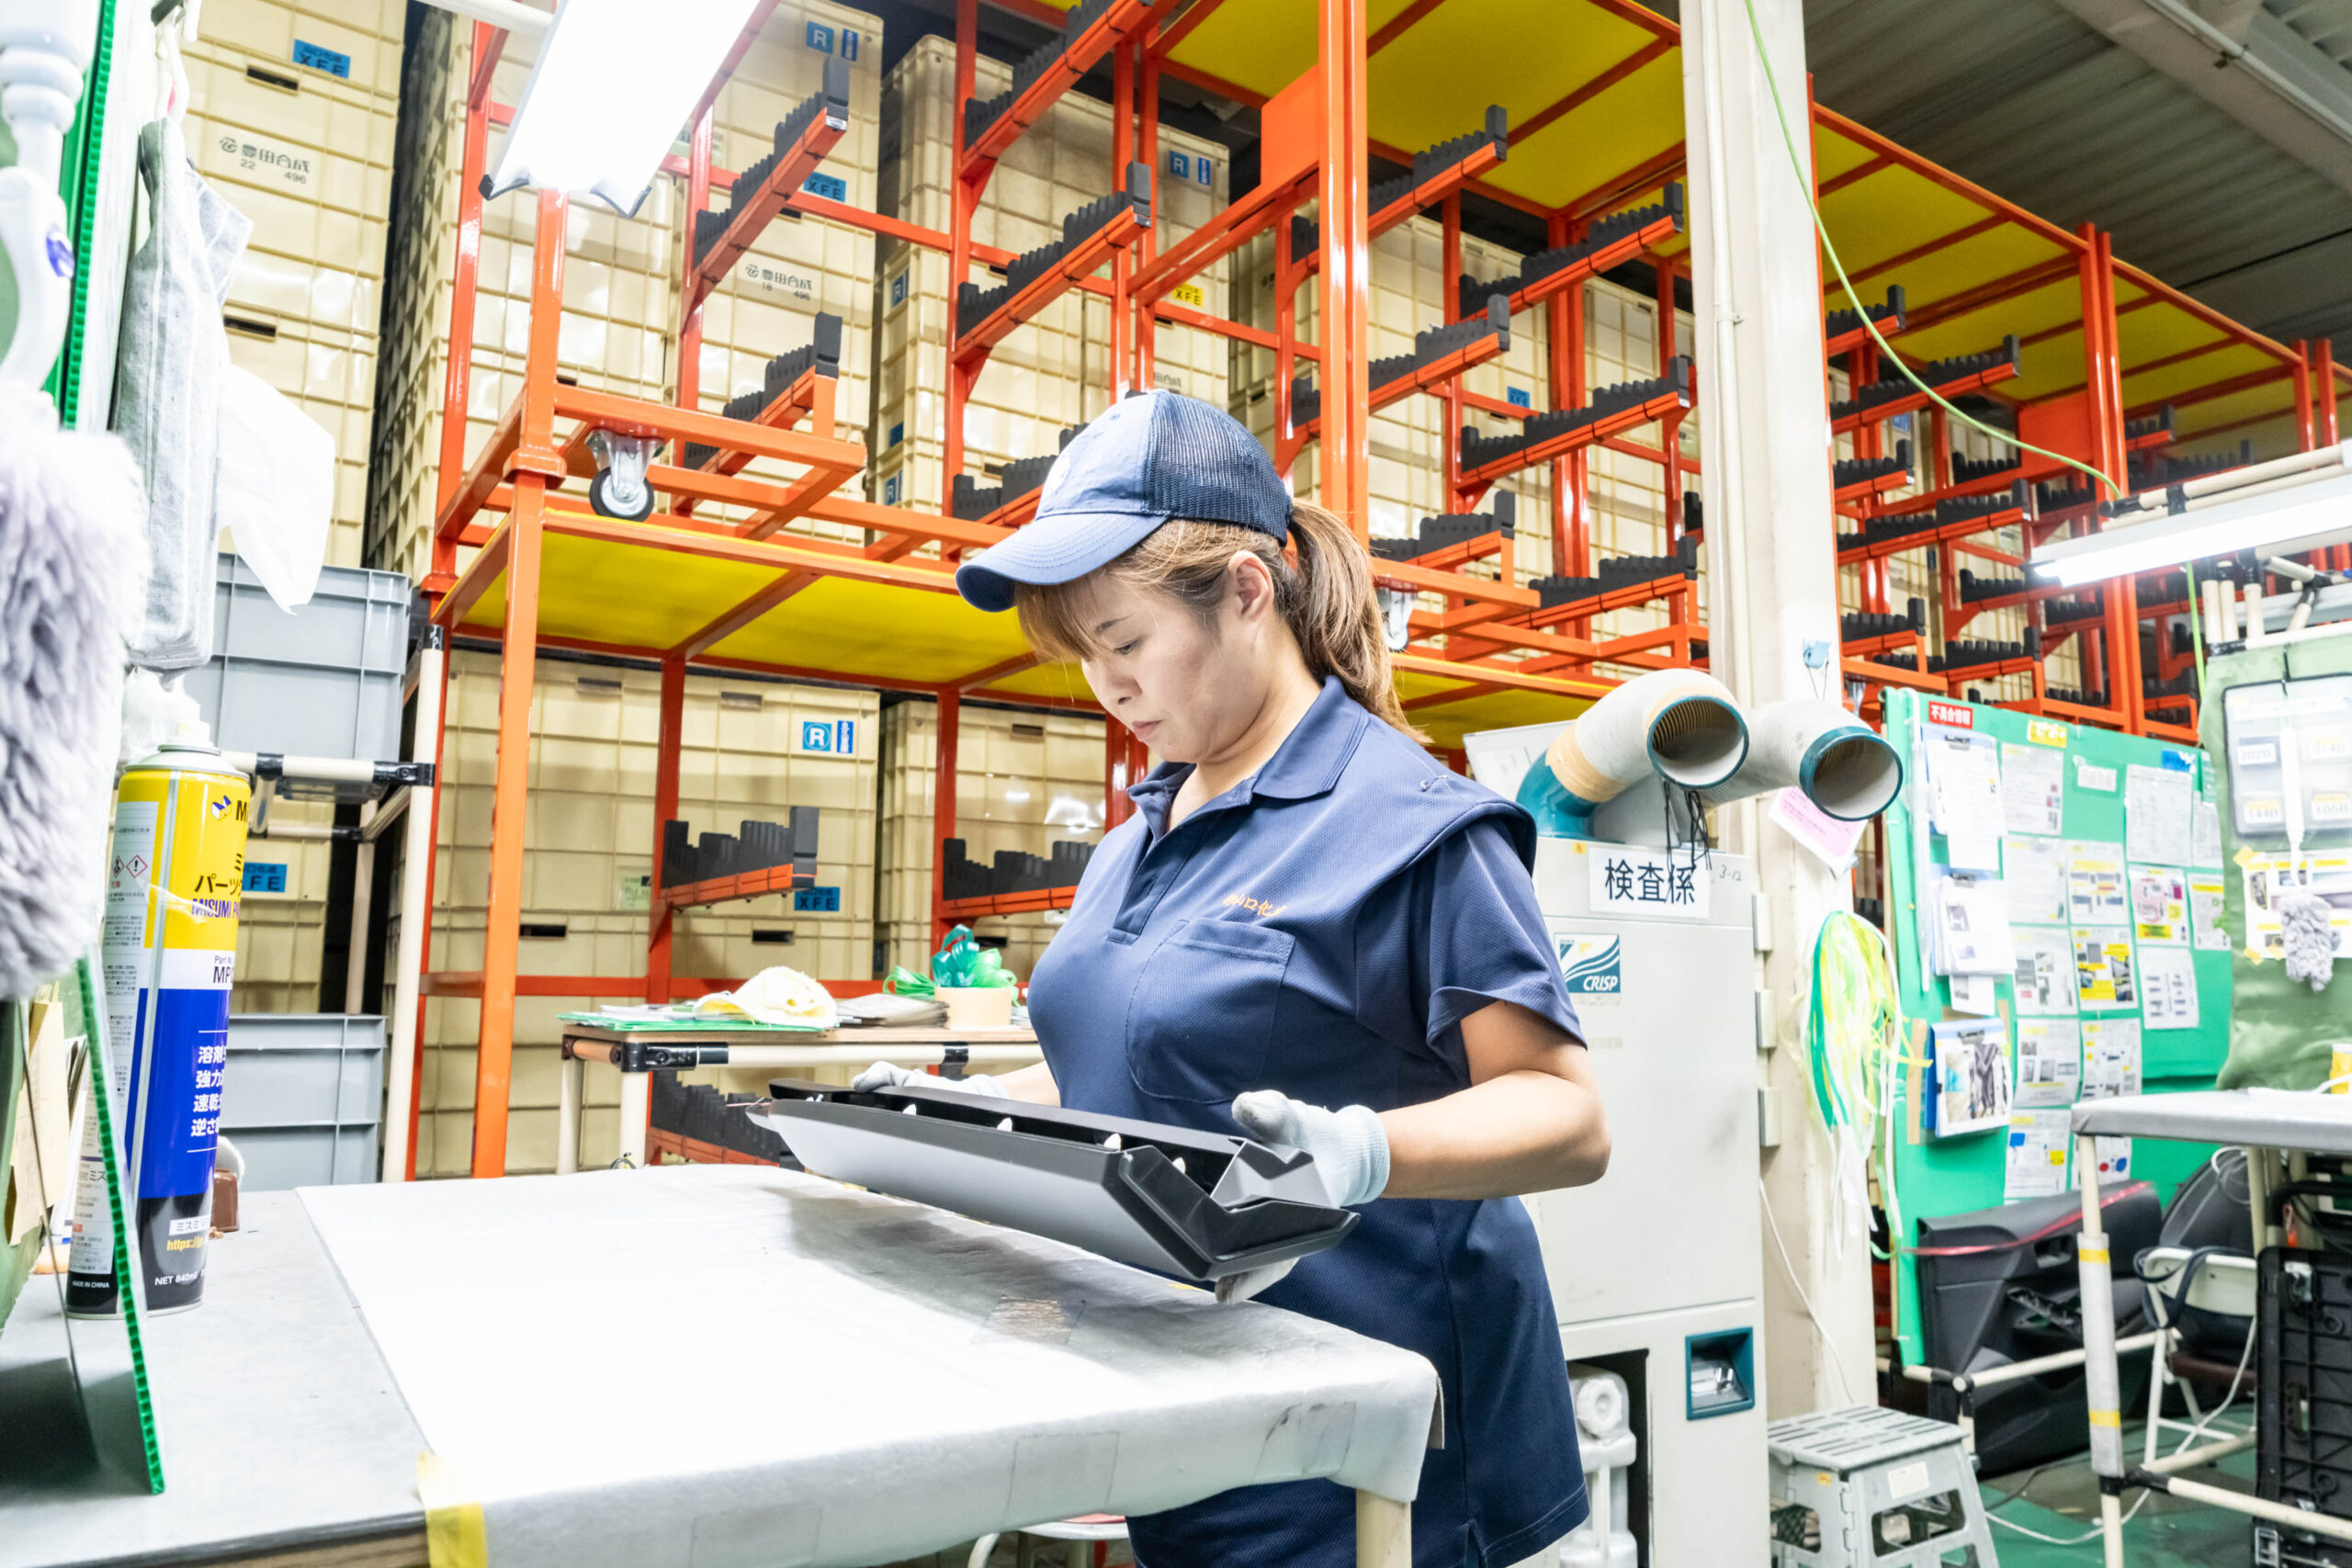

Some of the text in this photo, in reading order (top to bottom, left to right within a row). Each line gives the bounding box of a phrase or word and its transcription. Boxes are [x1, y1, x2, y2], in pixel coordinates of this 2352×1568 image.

[809, 728, 825, 746] R
[235, 800, 248, 823] M
[194, 874, 242, 897] パーツ
[1605, 858, 1697, 905] 検査係
[799, 897, 835, 910] XFE
[213, 966, 234, 984] MP
[1583, 976, 1618, 991] CRISP
[198, 1045, 227, 1065] 溶剤
[196, 1069, 224, 1089] 強力
[193, 1093, 222, 1112] 速乾
[190, 1117, 220, 1138] 逆さ
[154, 1276, 174, 1286] NET
